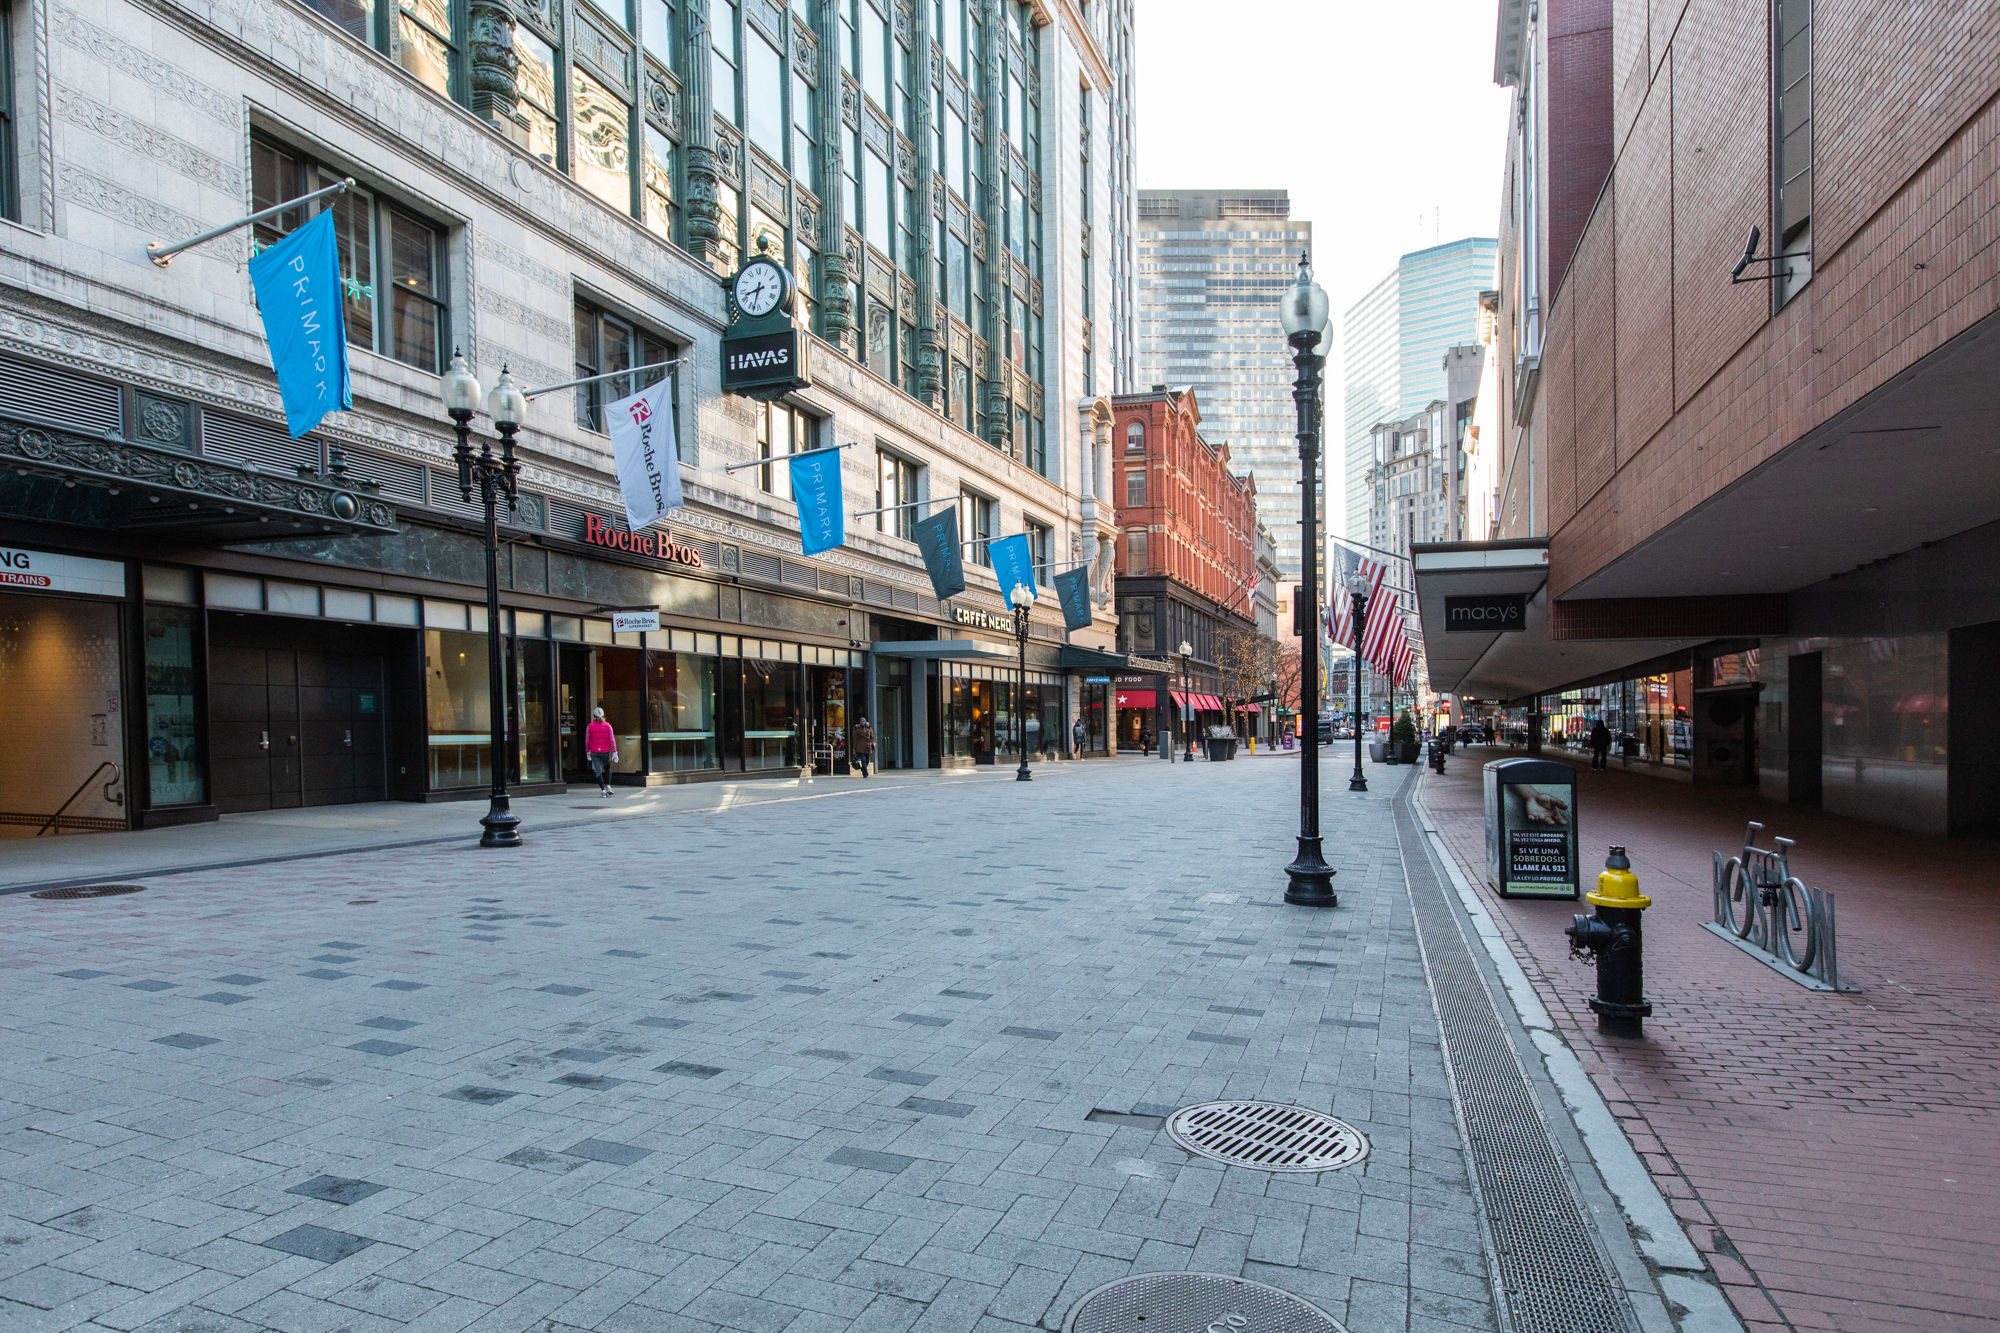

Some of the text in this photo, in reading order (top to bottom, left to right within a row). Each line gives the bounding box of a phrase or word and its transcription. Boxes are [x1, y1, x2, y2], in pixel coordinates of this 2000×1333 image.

[288, 255, 327, 400] PRIMARK
[730, 348, 789, 370] HAVAS
[640, 423, 665, 515] Roche Bros.
[810, 462, 832, 540] PRIMARK
[584, 513, 705, 567] Roche Bros.
[933, 523, 951, 571] PRIMA
[0, 573, 46, 586] TRAINS
[1069, 577, 1085, 623] PRIMARK
[1452, 602, 1518, 622] macy's
[988, 615, 1012, 632] NERO
[108, 698, 117, 711] 15
[1513, 855, 1565, 863] SOBREDOSIS
[1541, 864, 1551, 872] AL
